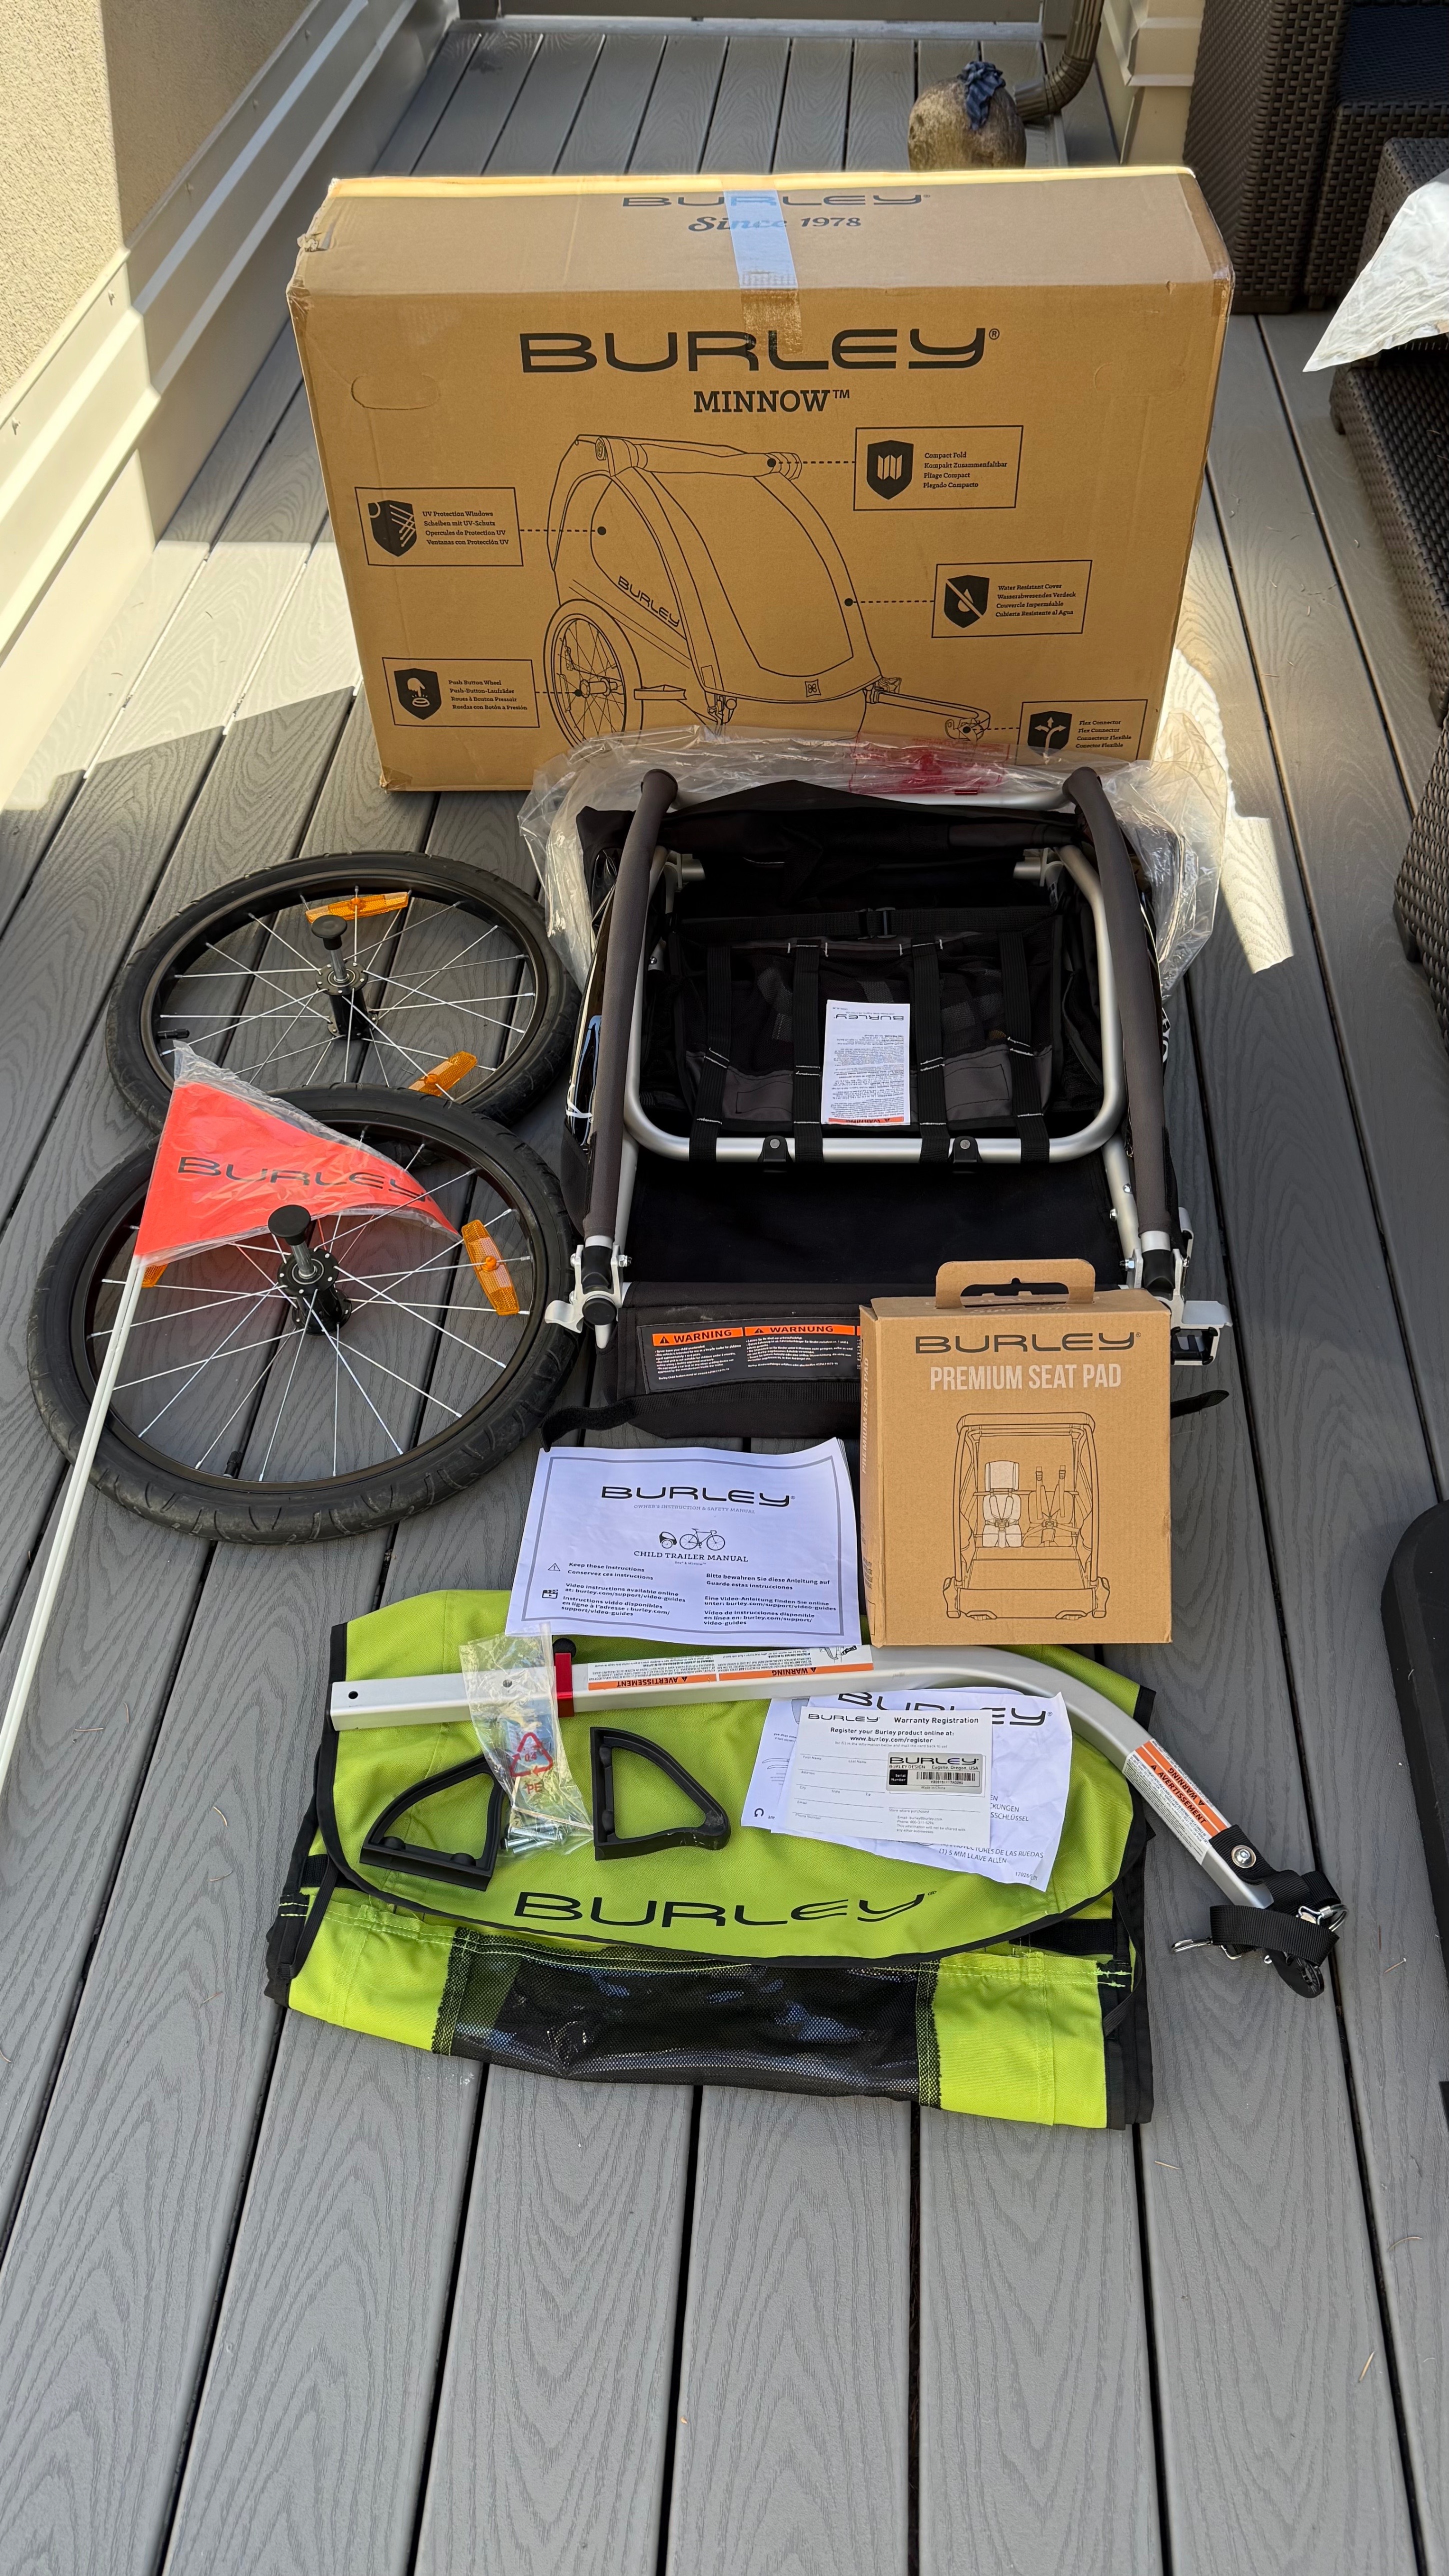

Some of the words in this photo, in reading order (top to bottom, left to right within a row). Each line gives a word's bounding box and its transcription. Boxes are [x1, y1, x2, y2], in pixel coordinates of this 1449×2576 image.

[688, 216, 787, 231] Since
[801, 216, 861, 227] 1978
[618, 576, 679, 627] BURLEY
[177, 1157, 427, 1202] BURLEY
[674, 1330, 732, 1343] WARNING
[930, 1365, 1023, 1390] PREMIUM
[1029, 1364, 1077, 1388] SEAT
[1083, 1363, 1122, 1387] PAD
[576, 1589, 686, 1602] burley.com/support/video-guides
[561, 1606, 633, 1616] support/video-guides
[617, 1676, 678, 1687] AVERTISSEMENT
[525, 1753, 536, 1761] 04
[527, 1784, 542, 1794] PE
[1168, 1768, 1198, 1800] WARNING
[1158, 1772, 1207, 1824] AVERTISSEMENT
[968, 1852, 987, 1861] LLAVE
